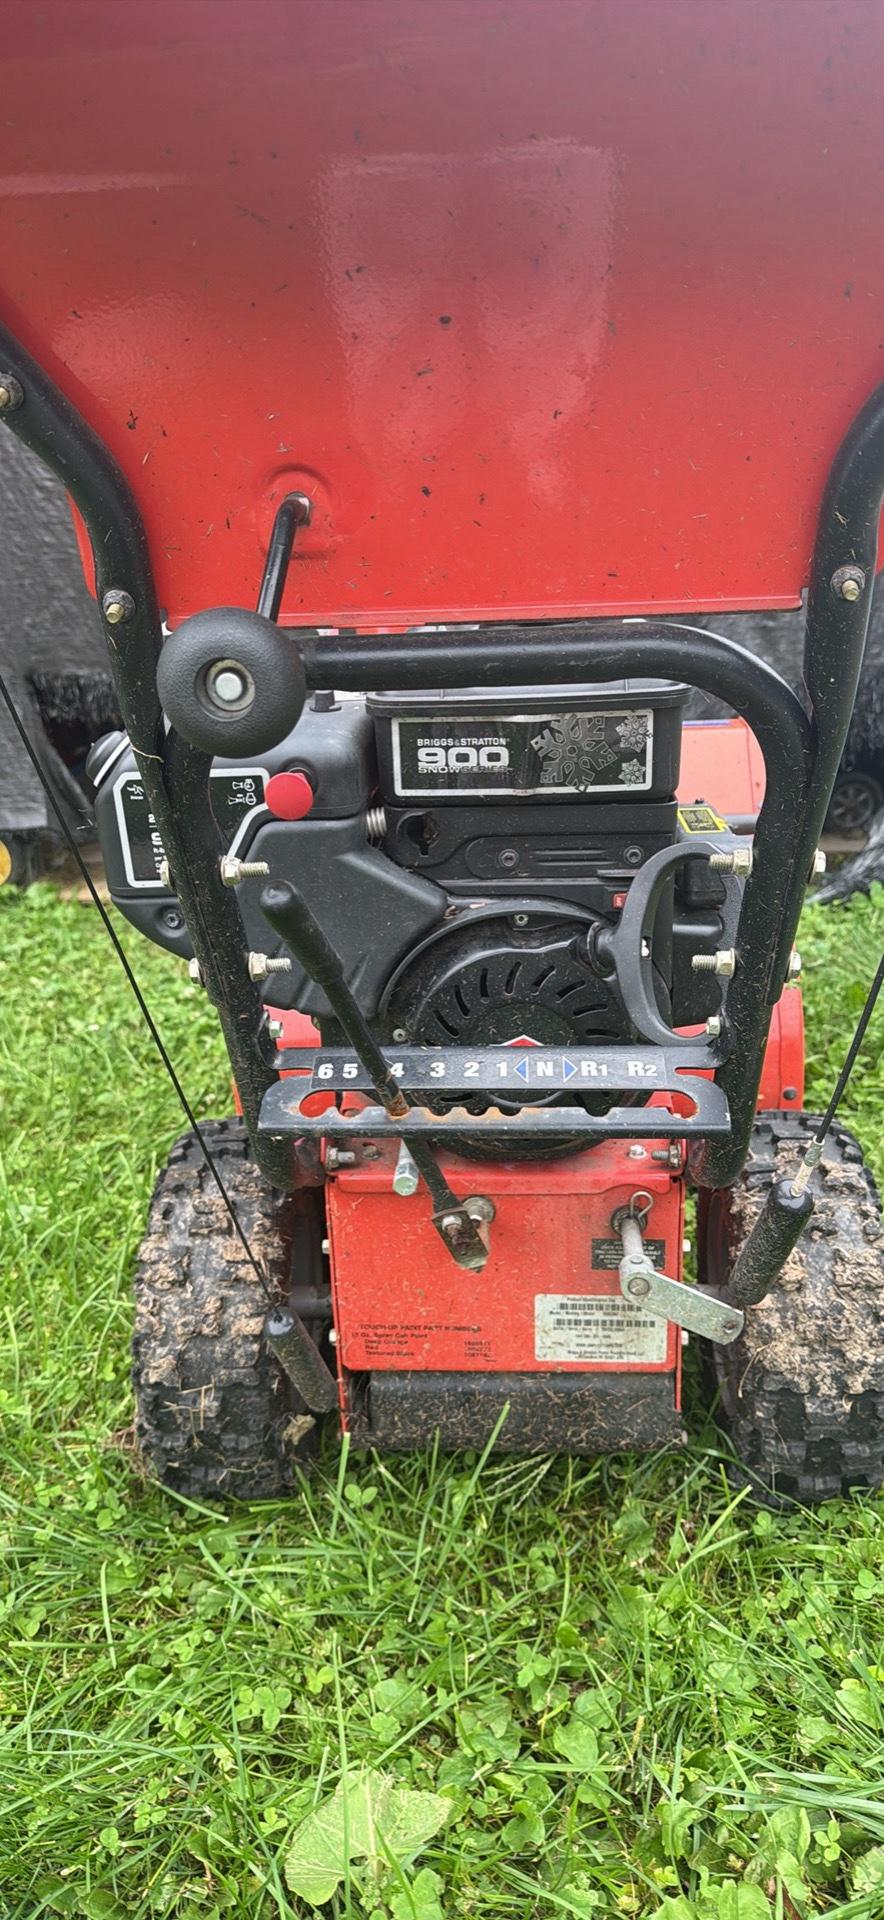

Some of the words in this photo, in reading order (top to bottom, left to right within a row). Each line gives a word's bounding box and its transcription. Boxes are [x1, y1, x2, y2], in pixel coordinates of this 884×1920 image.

[417, 746, 509, 767] 900
[317, 1063, 334, 1079] 6
[342, 1063, 358, 1079] 5
[390, 1062, 405, 1078] 4
[430, 1062, 446, 1078] 3
[463, 1062, 480, 1077] 2
[496, 1061, 508, 1077] 1
[536, 1061, 554, 1077] N
[581, 1061, 608, 1077] R1
[627, 1061, 658, 1077] R2
